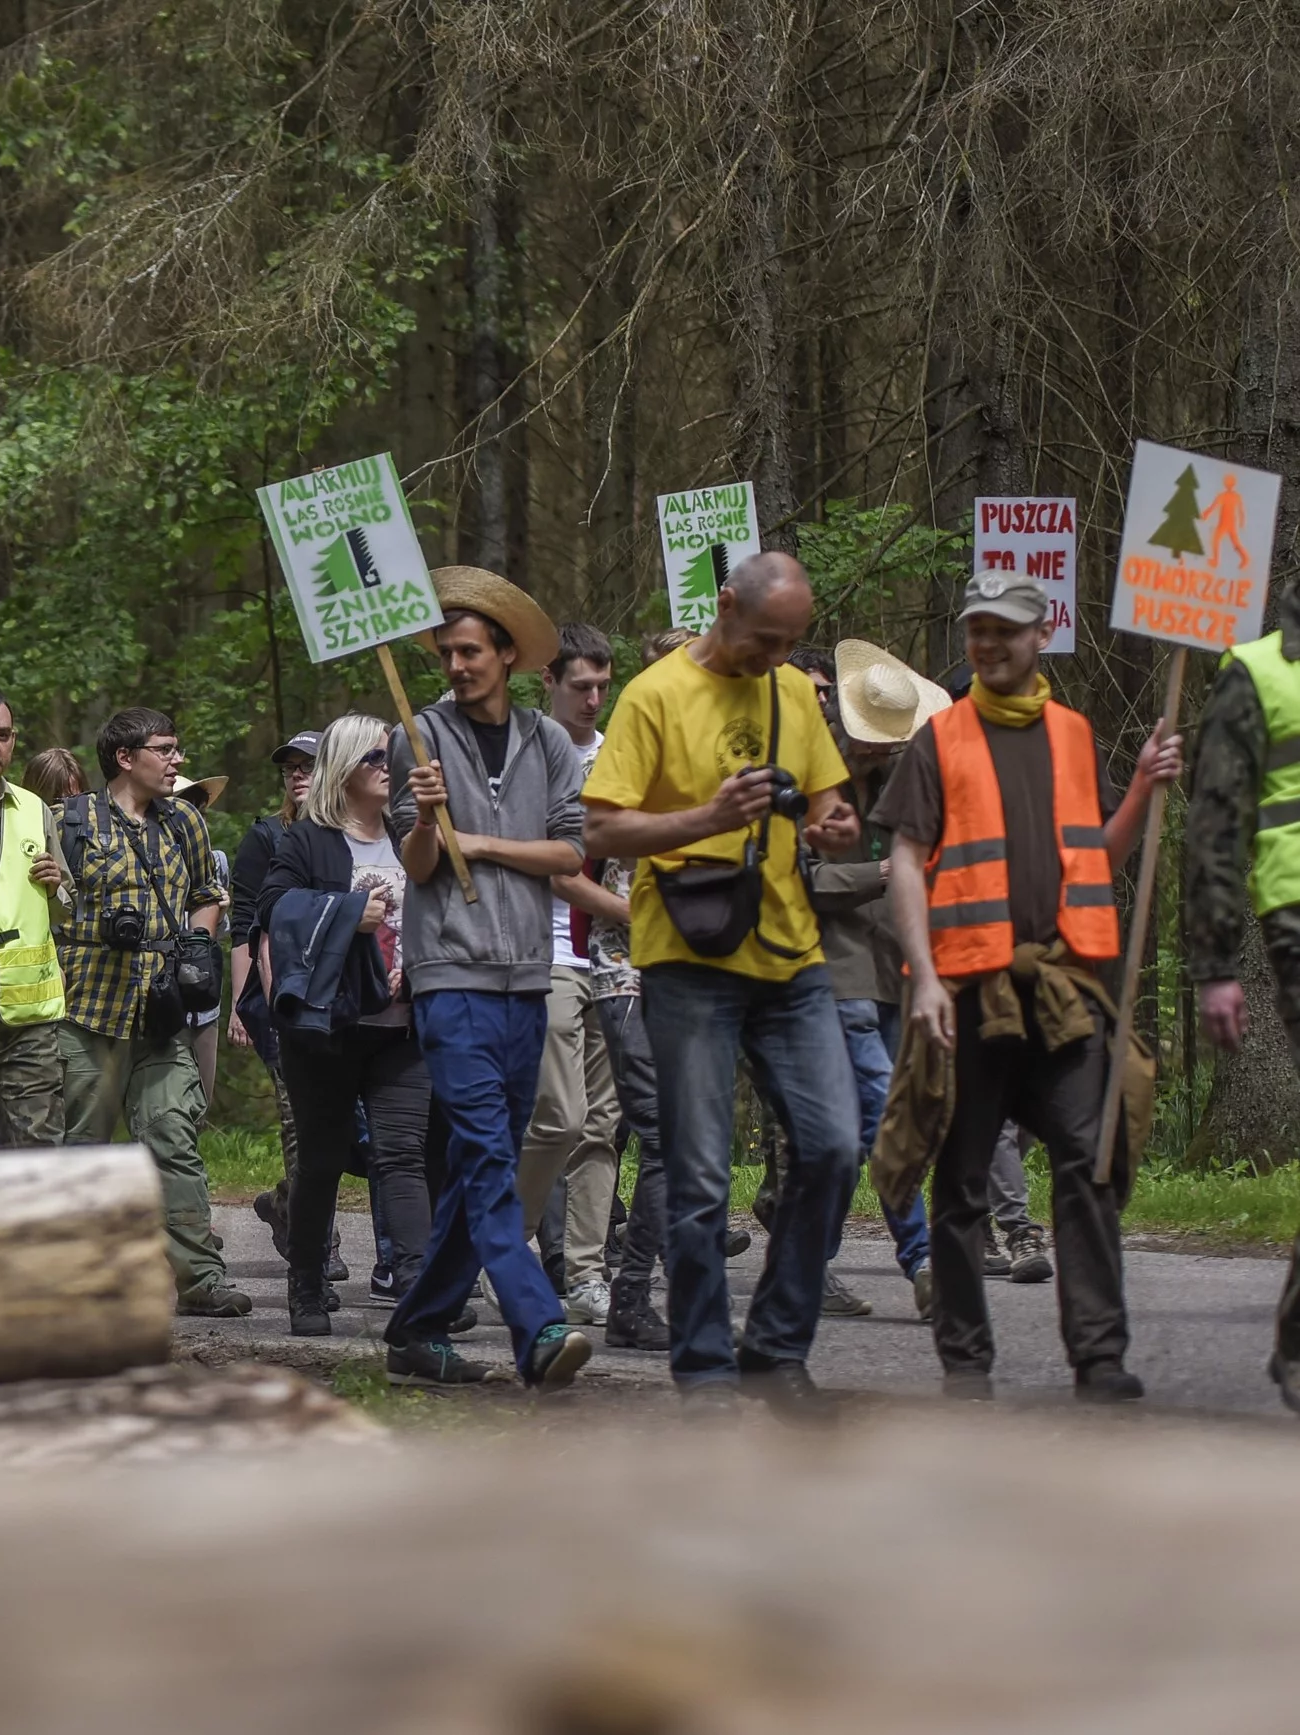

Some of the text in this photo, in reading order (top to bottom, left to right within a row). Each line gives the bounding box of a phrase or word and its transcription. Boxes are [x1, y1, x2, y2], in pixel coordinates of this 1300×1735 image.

[279, 456, 382, 507] ALARMUJ
[282, 504, 318, 527] LAS
[663, 485, 748, 518] ALARMUJ
[981, 502, 1073, 534] PUSZCZA
[289, 503, 392, 546] WOLNO
[665, 518, 693, 535] LAS
[668, 527, 750, 552] WOLNO
[982, 550, 1066, 580] TO NIE
[1123, 556, 1254, 608] OTWÓRZCIE
[315, 580, 425, 625] ZNIKA
[323, 601, 431, 649] SZYBKO
